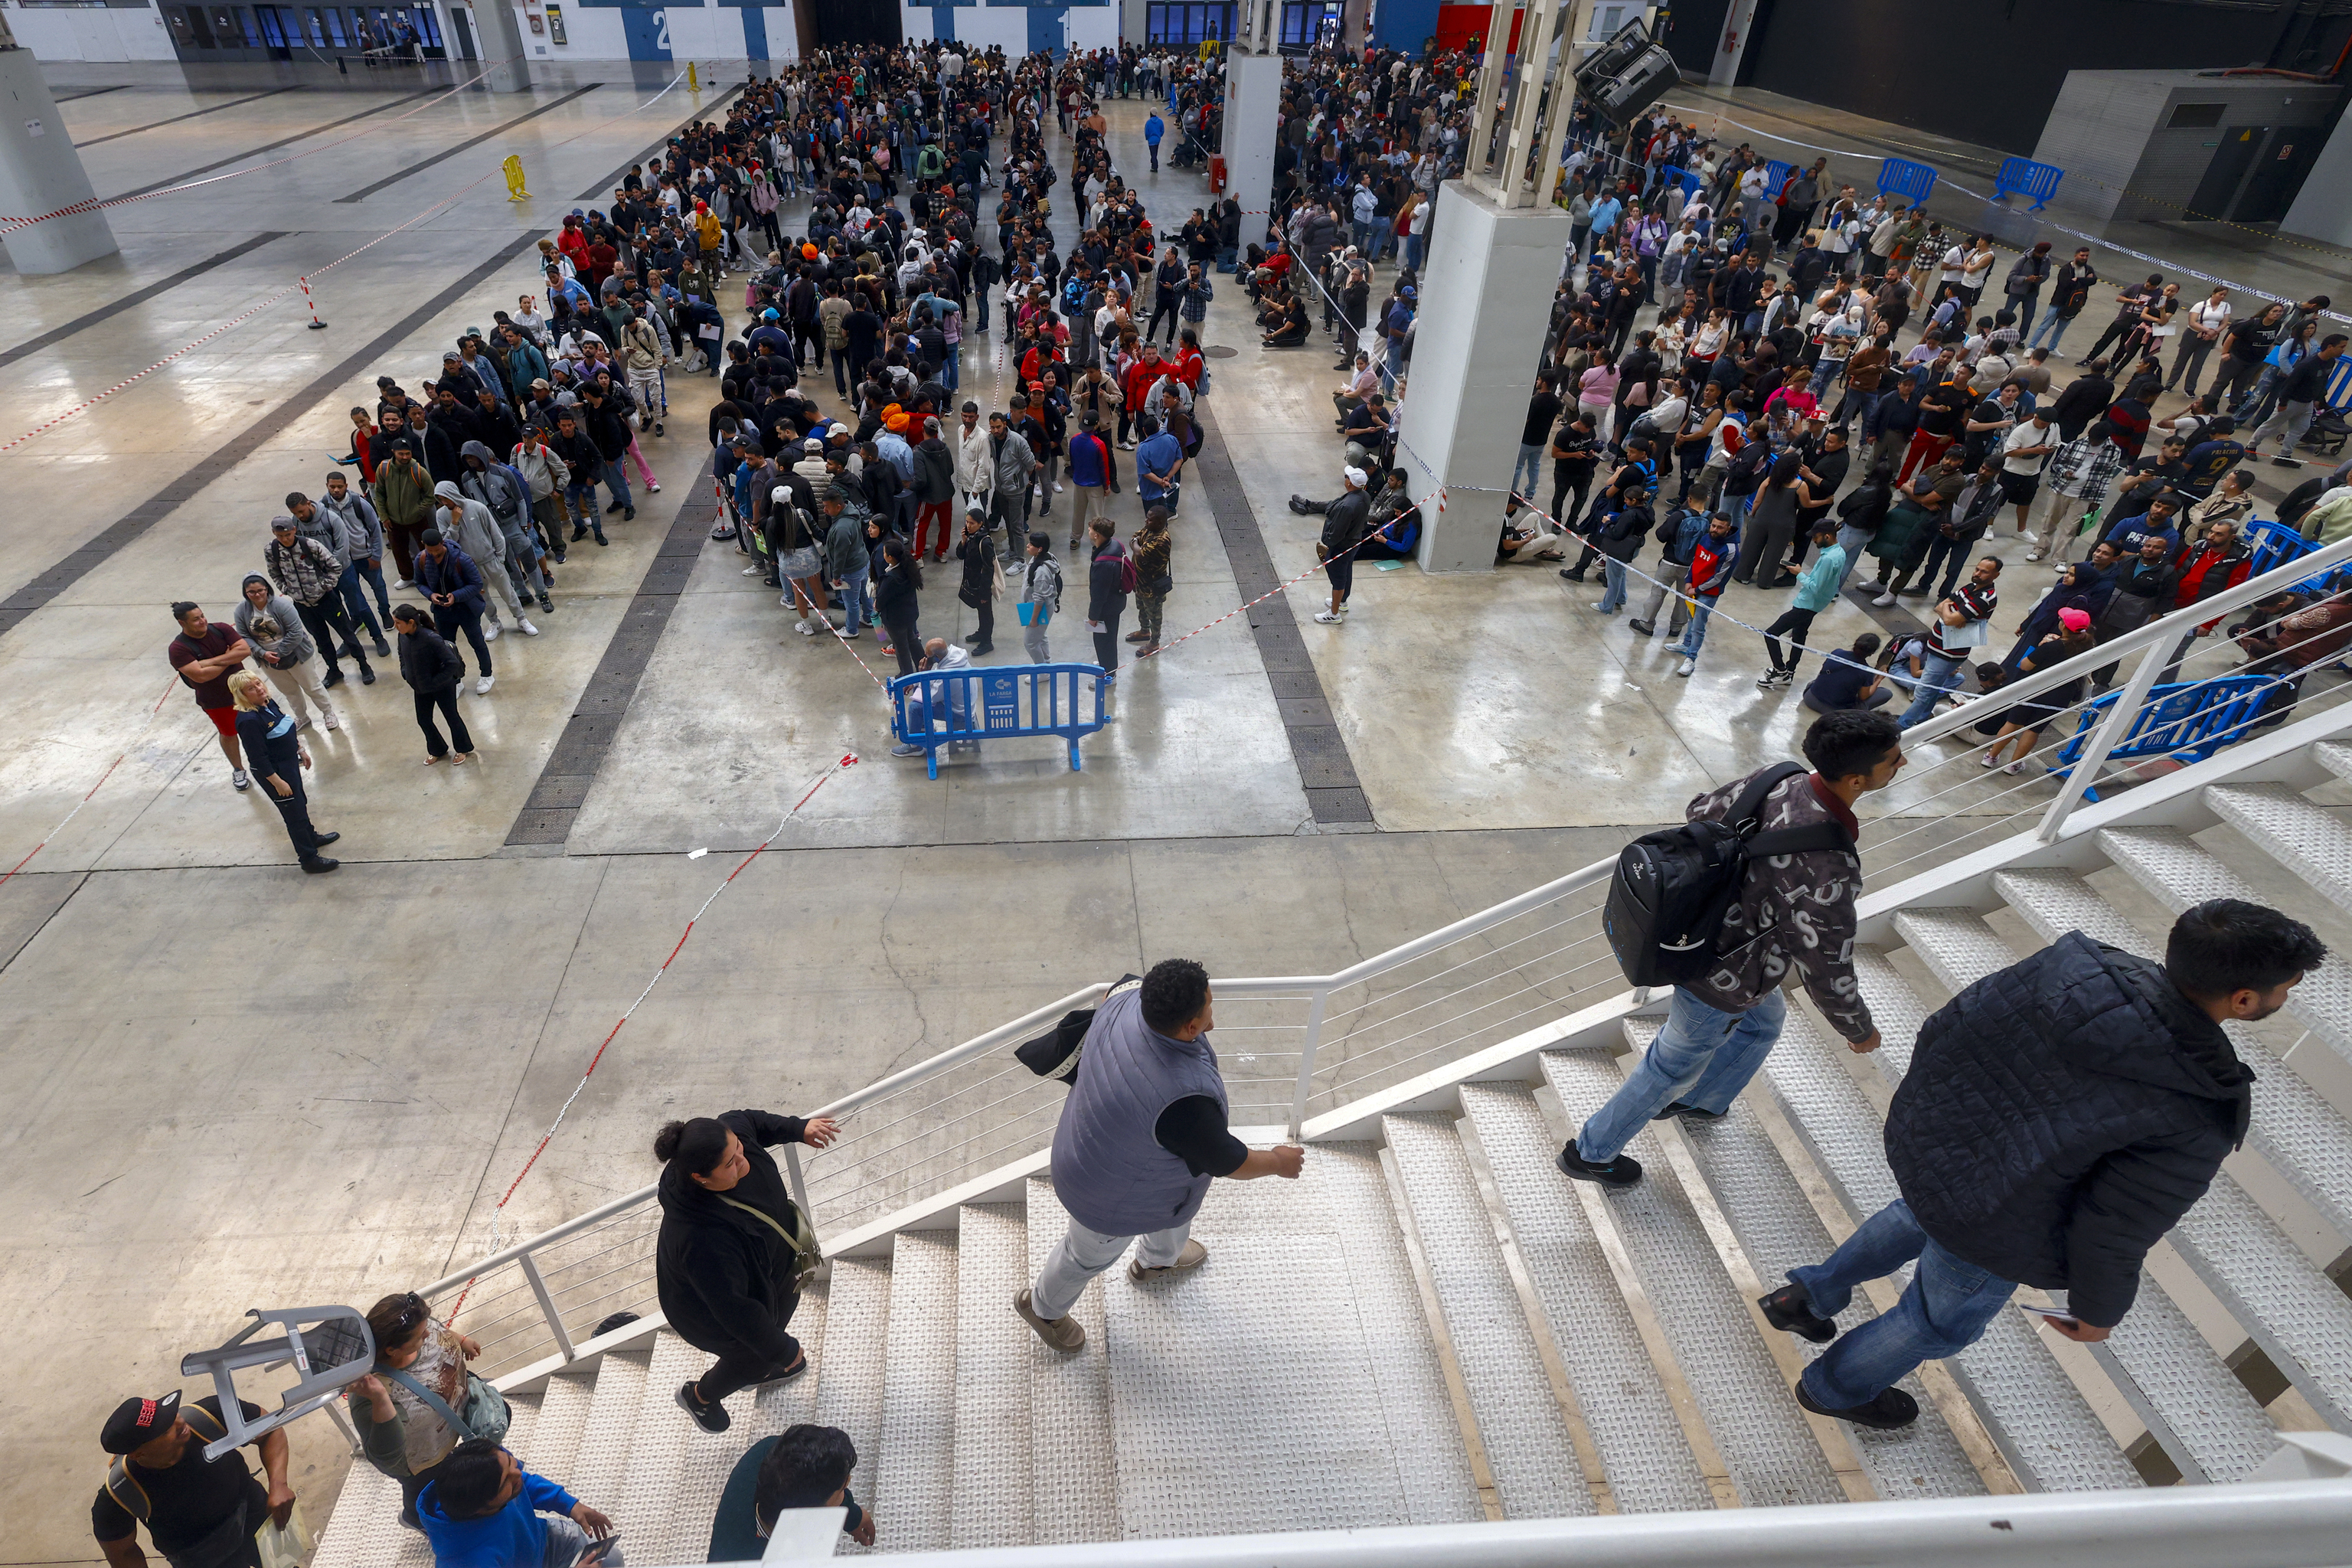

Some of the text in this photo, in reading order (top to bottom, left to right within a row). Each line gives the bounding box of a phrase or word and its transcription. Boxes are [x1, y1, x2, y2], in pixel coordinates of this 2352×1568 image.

[653, 11, 671, 50] 2
[1057, 10, 1069, 50] 1
[2209, 456, 2229, 475] 9
[1051, 1061, 1072, 1079] FAIRLY
